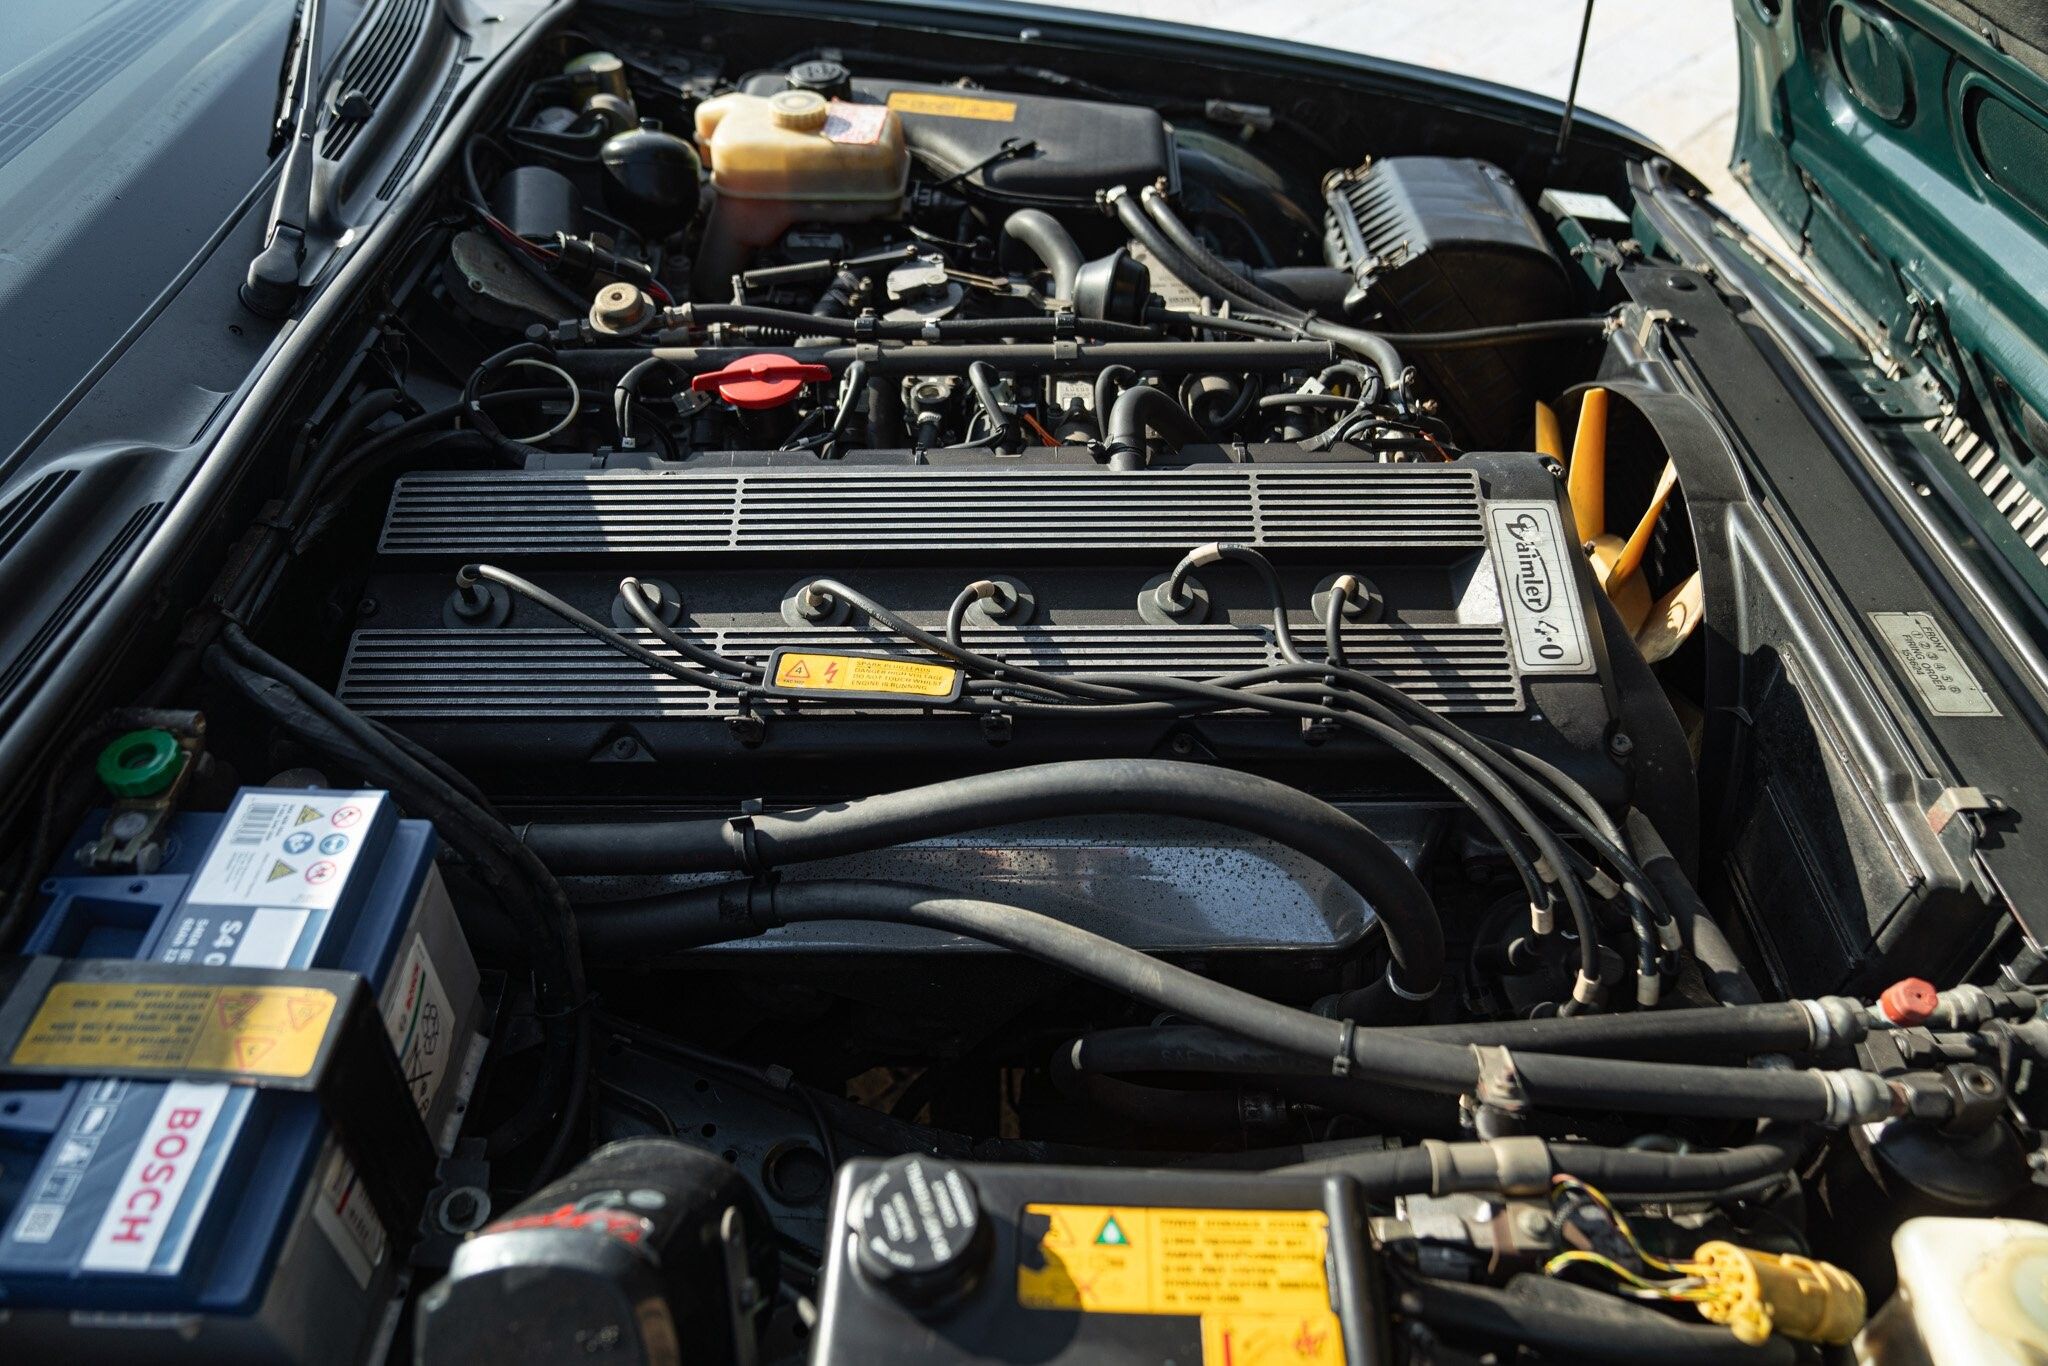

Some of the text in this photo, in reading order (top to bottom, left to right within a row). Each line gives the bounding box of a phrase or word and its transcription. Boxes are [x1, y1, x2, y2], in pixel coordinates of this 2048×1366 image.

[1505, 514, 1549, 610] Daimler
[1923, 626, 1948, 653] FRONT
[795, 667, 803, 675] 4
[1902, 649, 1925, 675] 153624
[1902, 634, 1947, 691] FIRING ORDER
[111, 1108, 202, 1243] BOSCH
